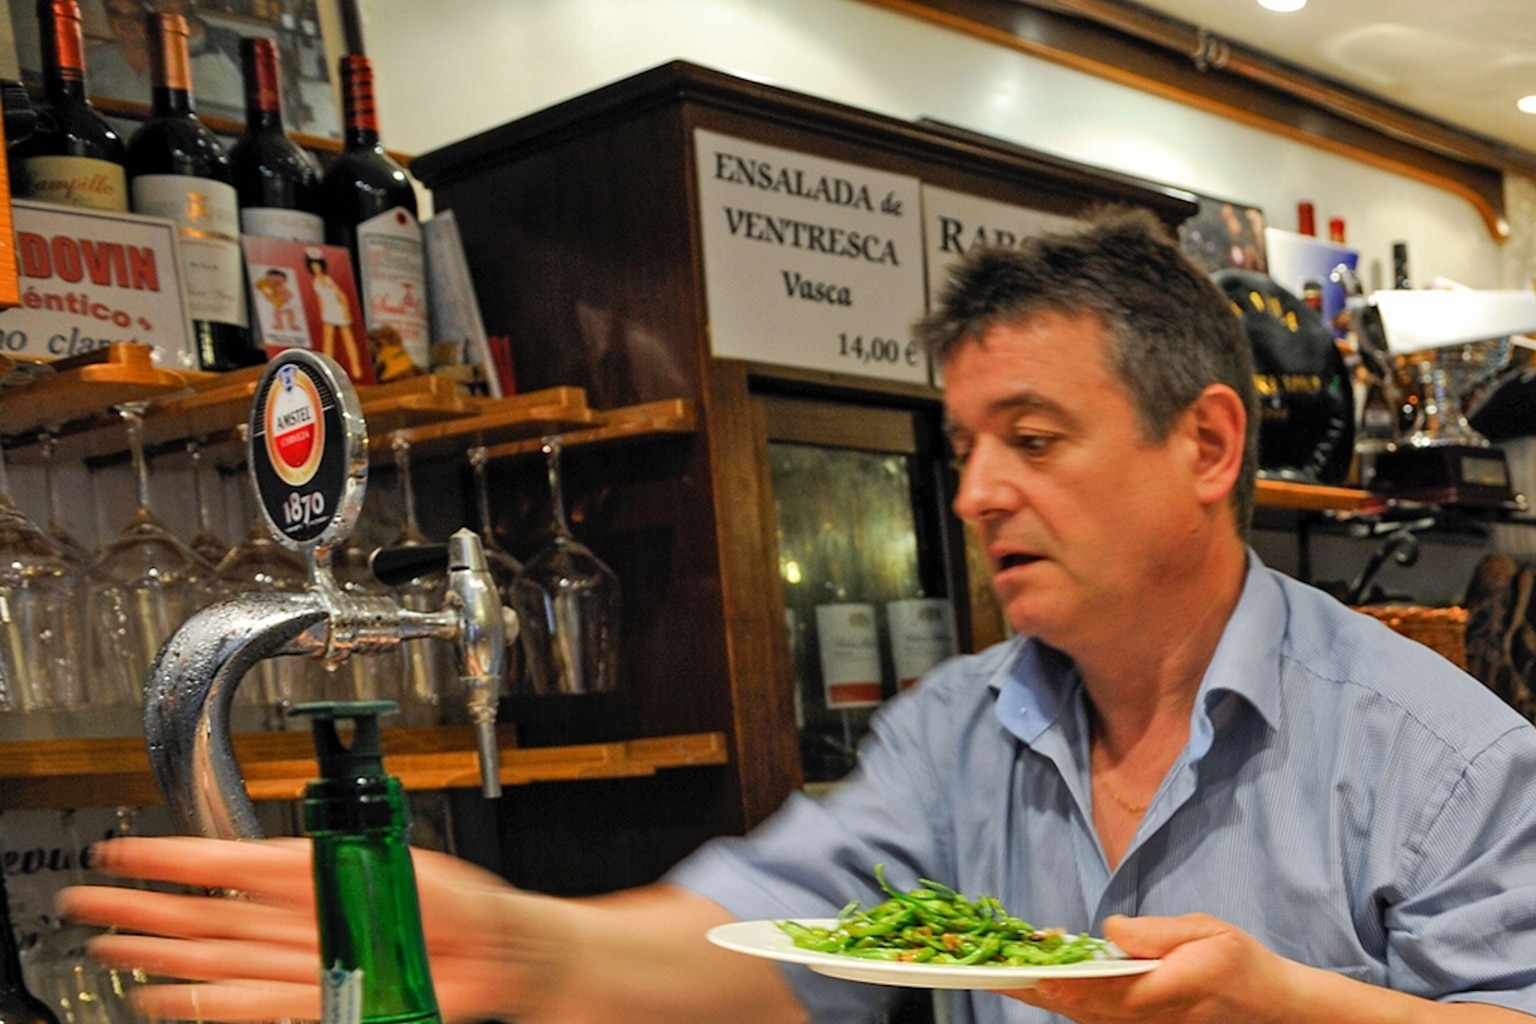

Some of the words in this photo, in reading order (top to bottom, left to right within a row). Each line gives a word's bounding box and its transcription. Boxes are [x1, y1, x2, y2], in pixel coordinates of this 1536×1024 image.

[33, 172, 115, 200] ampillo
[713, 151, 873, 212] ENSALADA
[880, 190, 903, 217] de
[723, 206, 900, 267] VENTRESCA
[937, 214, 1036, 256] RAB
[17, 231, 160, 293] DOVIN
[780, 269, 853, 308] Vasca
[838, 331, 899, 365] 14,00
[905, 339, 918, 367] €
[276, 405, 312, 431] AMSTEL
[283, 491, 325, 525] 1870
